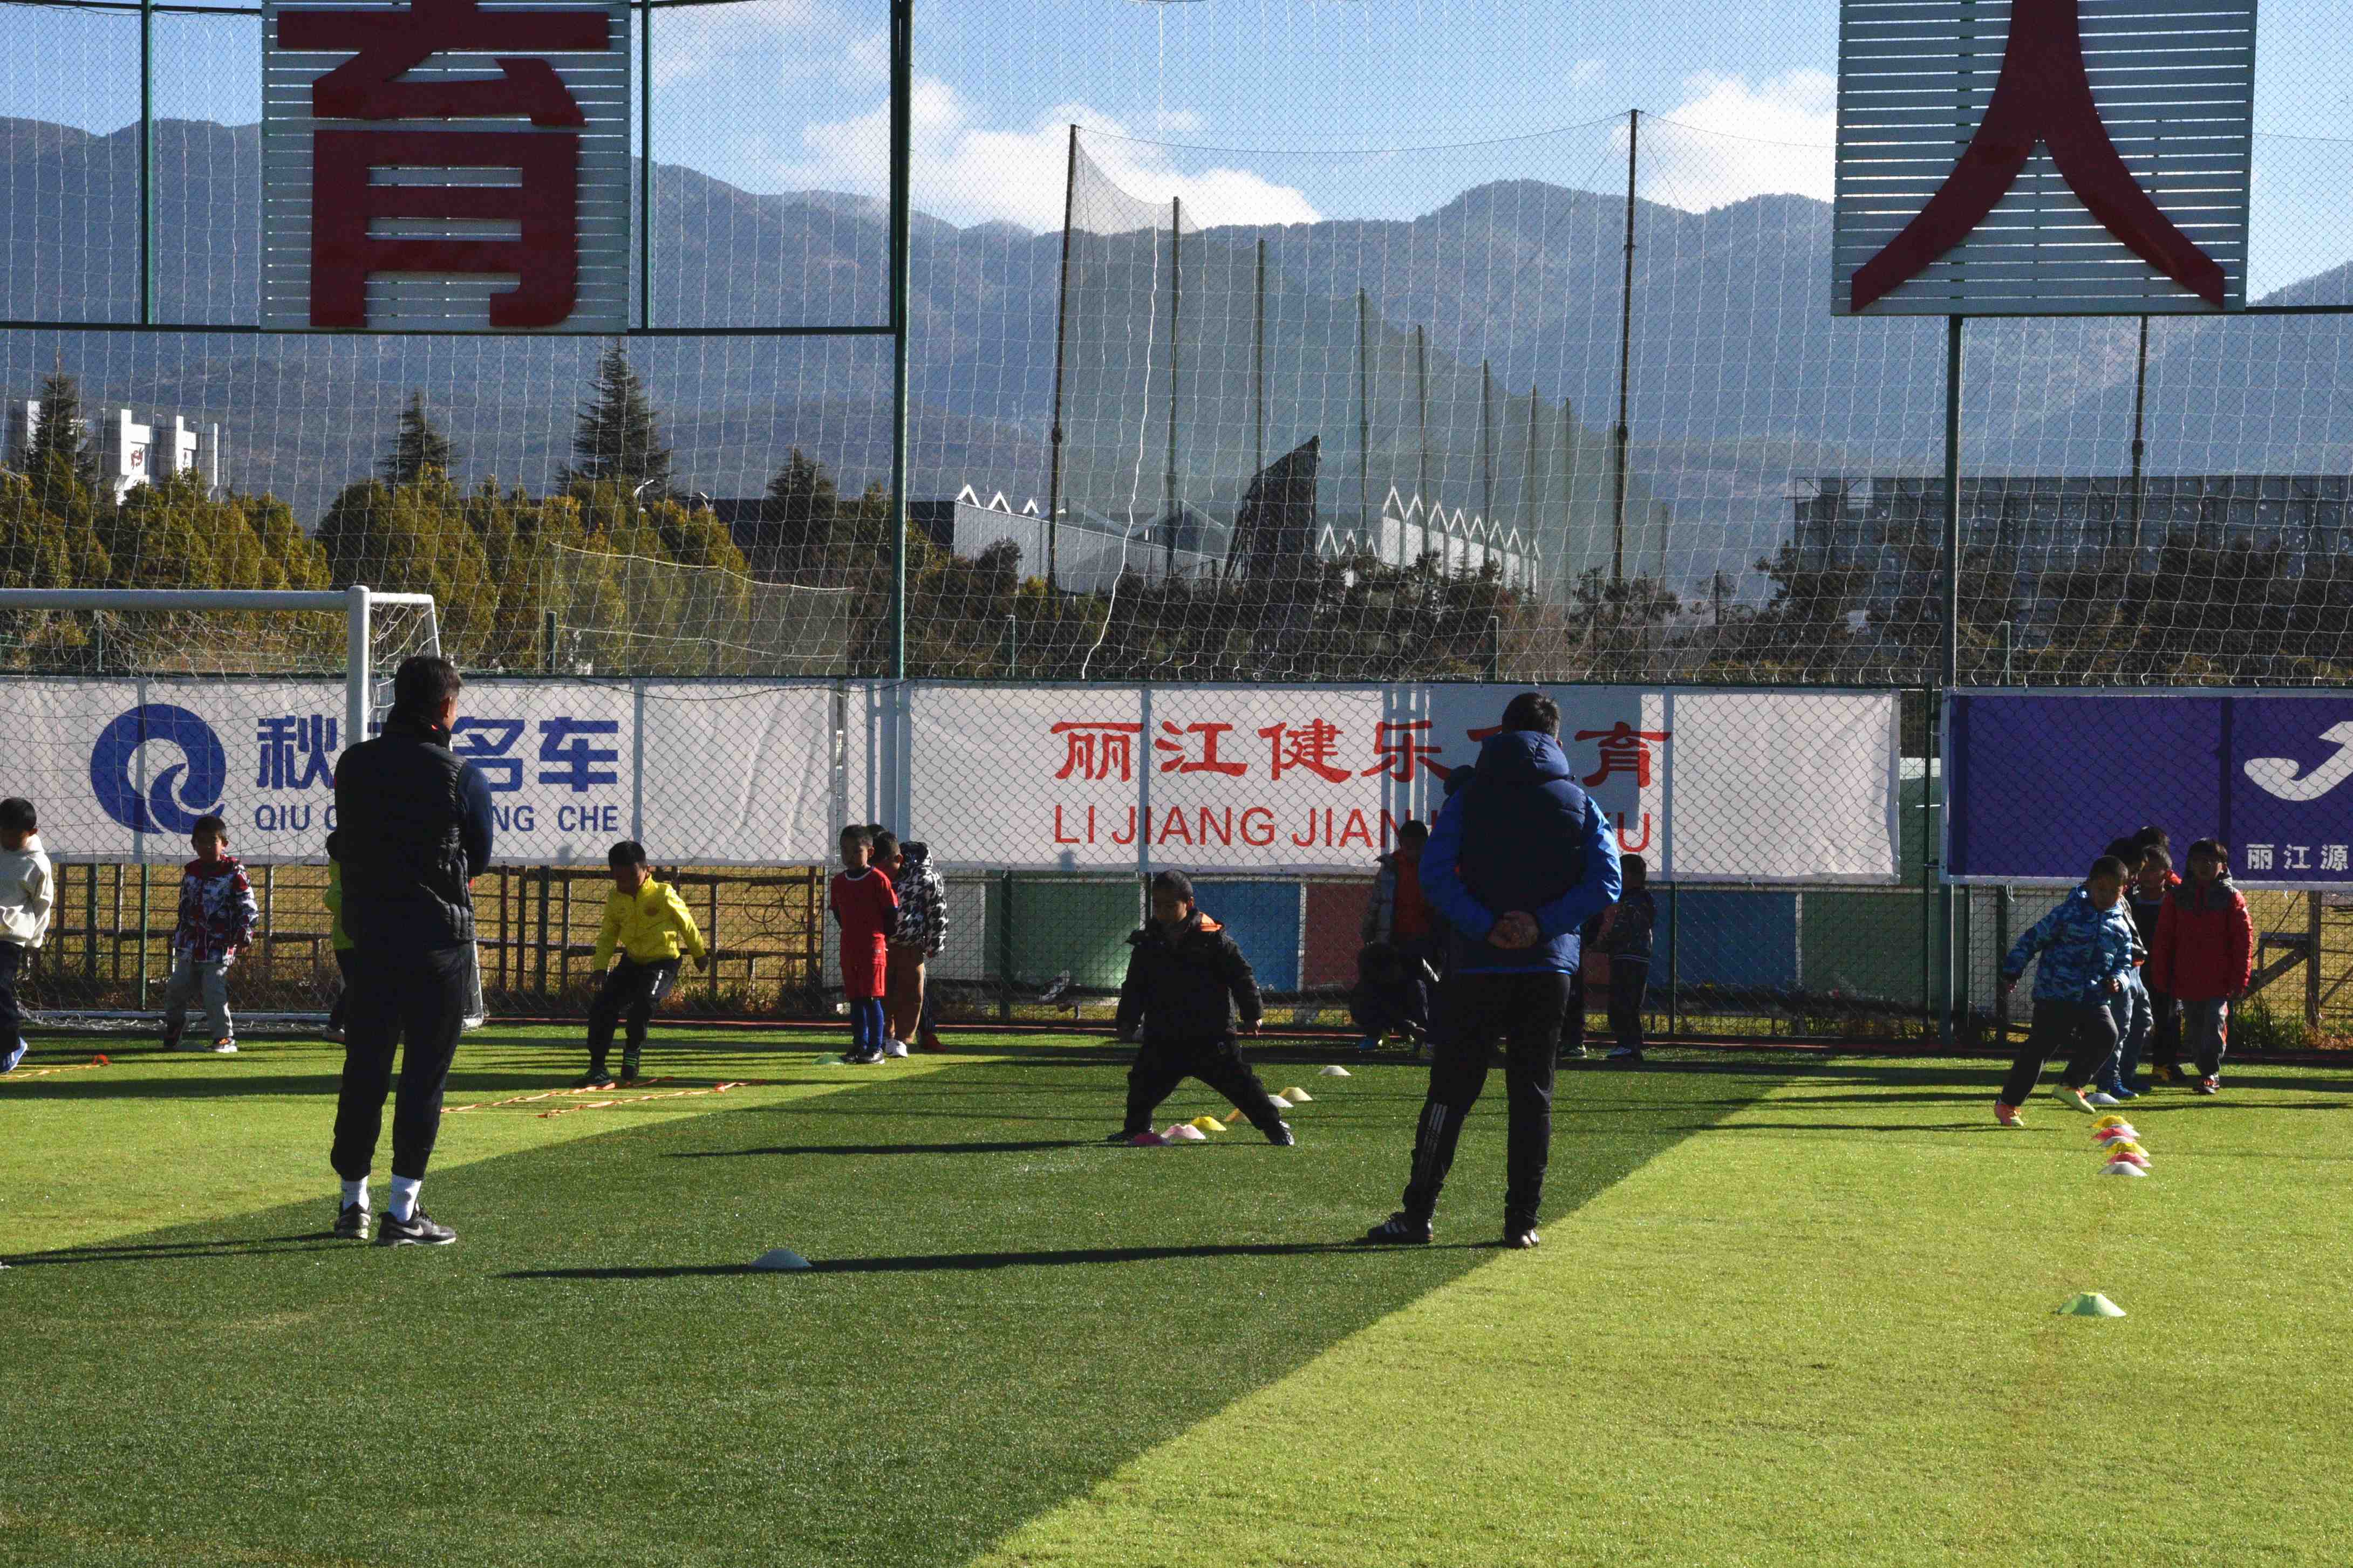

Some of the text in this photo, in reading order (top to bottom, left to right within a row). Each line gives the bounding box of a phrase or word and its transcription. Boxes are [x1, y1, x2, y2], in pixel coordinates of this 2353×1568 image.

[277, 0, 610, 327] 育
[1851, 0, 2225, 313] 人
[256, 714, 618, 792] 秋名车
[1051, 718, 1672, 788] 丽江健乐育
[255, 804, 310, 831] QIU
[492, 805, 534, 831] NG
[558, 805, 618, 831] CHE
[2246, 844, 2349, 871] 丽江源
